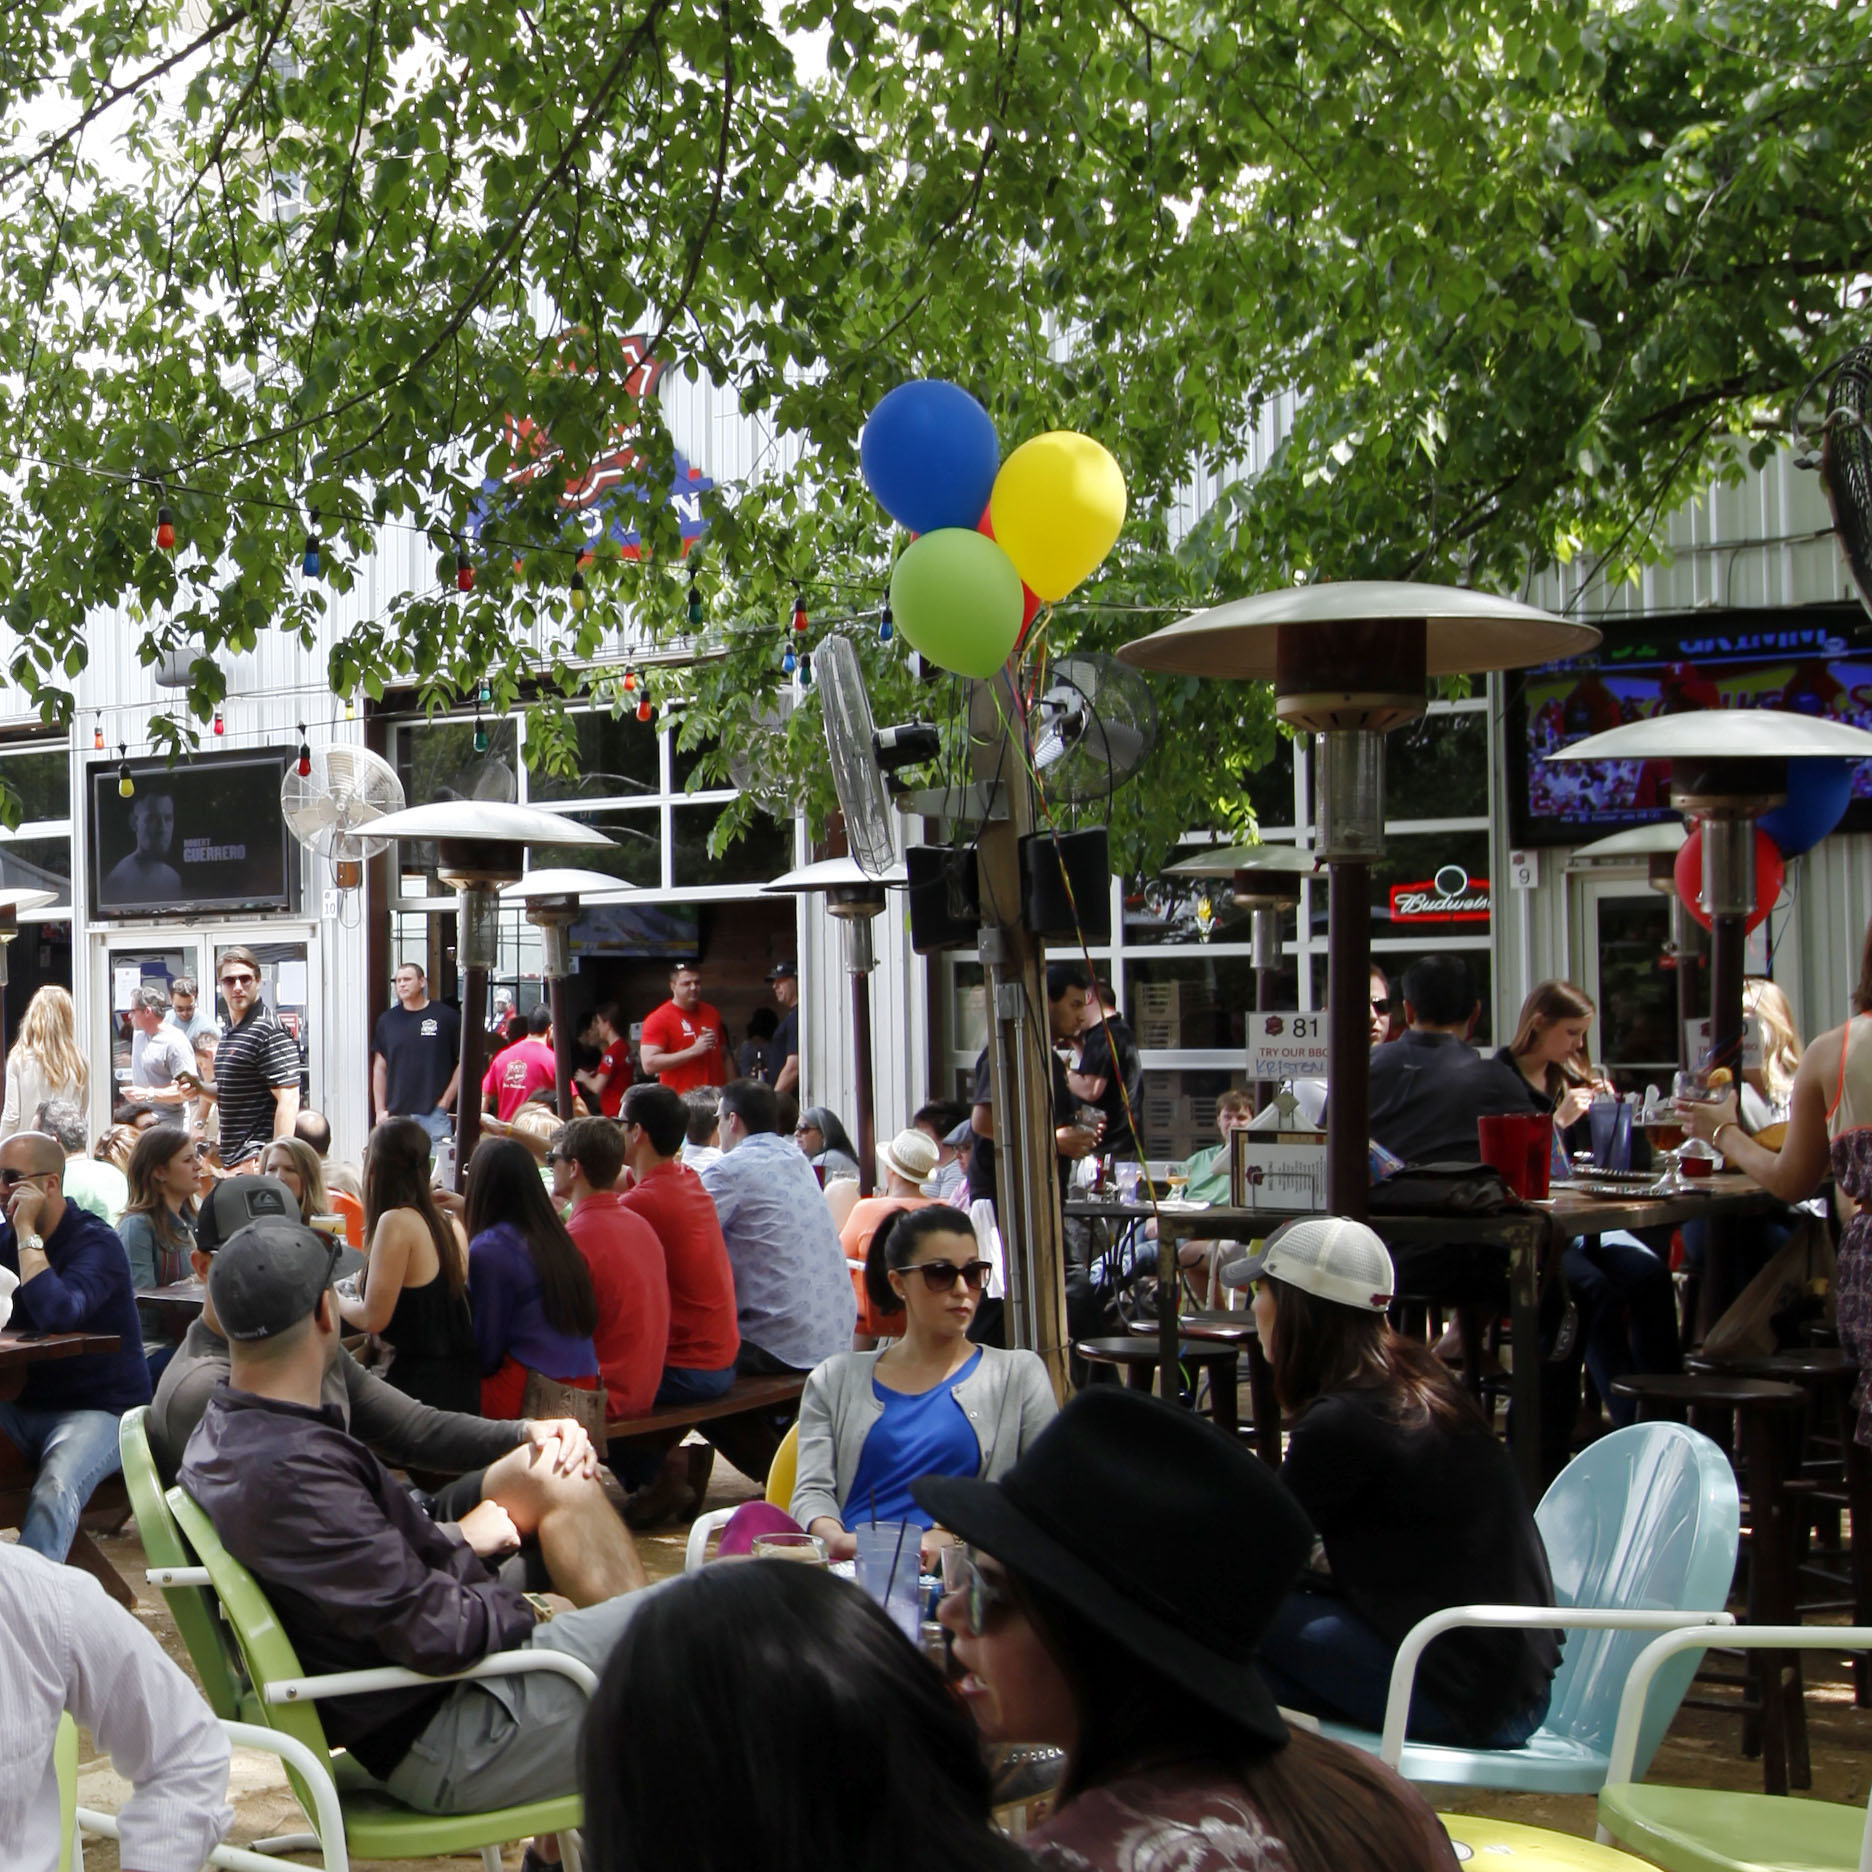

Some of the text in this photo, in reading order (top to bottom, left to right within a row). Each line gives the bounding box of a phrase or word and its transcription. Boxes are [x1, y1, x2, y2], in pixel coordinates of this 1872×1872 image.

[183, 844, 246, 863] GUERRERO
[1519, 868, 1530, 884] 9
[325, 903, 336, 914] 10
[1394, 893, 1490, 914] Budweis
[1293, 1017, 1318, 1038] 81
[1259, 1048, 1279, 1057] TRY
[1281, 1048, 1305, 1058] OUR
